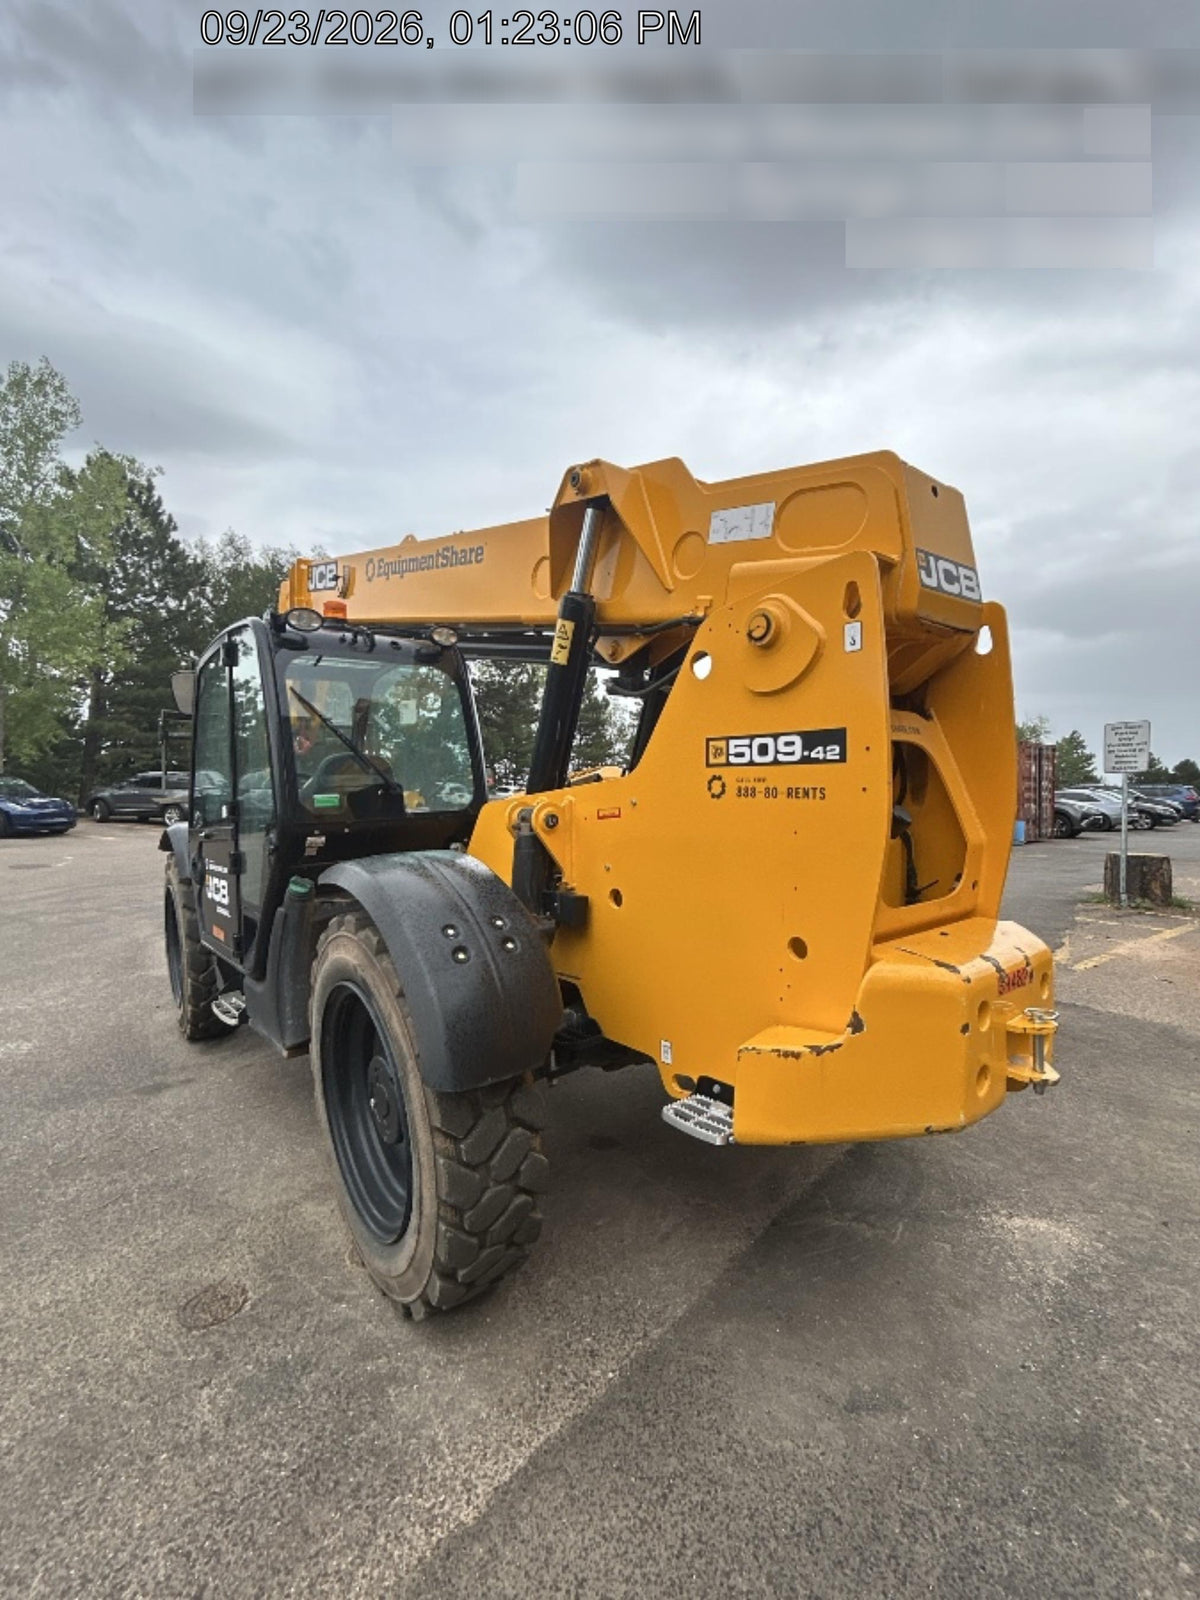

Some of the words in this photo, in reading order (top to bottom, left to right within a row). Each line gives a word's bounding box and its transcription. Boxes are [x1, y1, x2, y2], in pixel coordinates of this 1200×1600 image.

[308, 562, 337, 591] JCB
[376, 545, 485, 580] EquipmentShare
[920, 555, 981, 600] JCB
[206, 874, 229, 905] JCB
